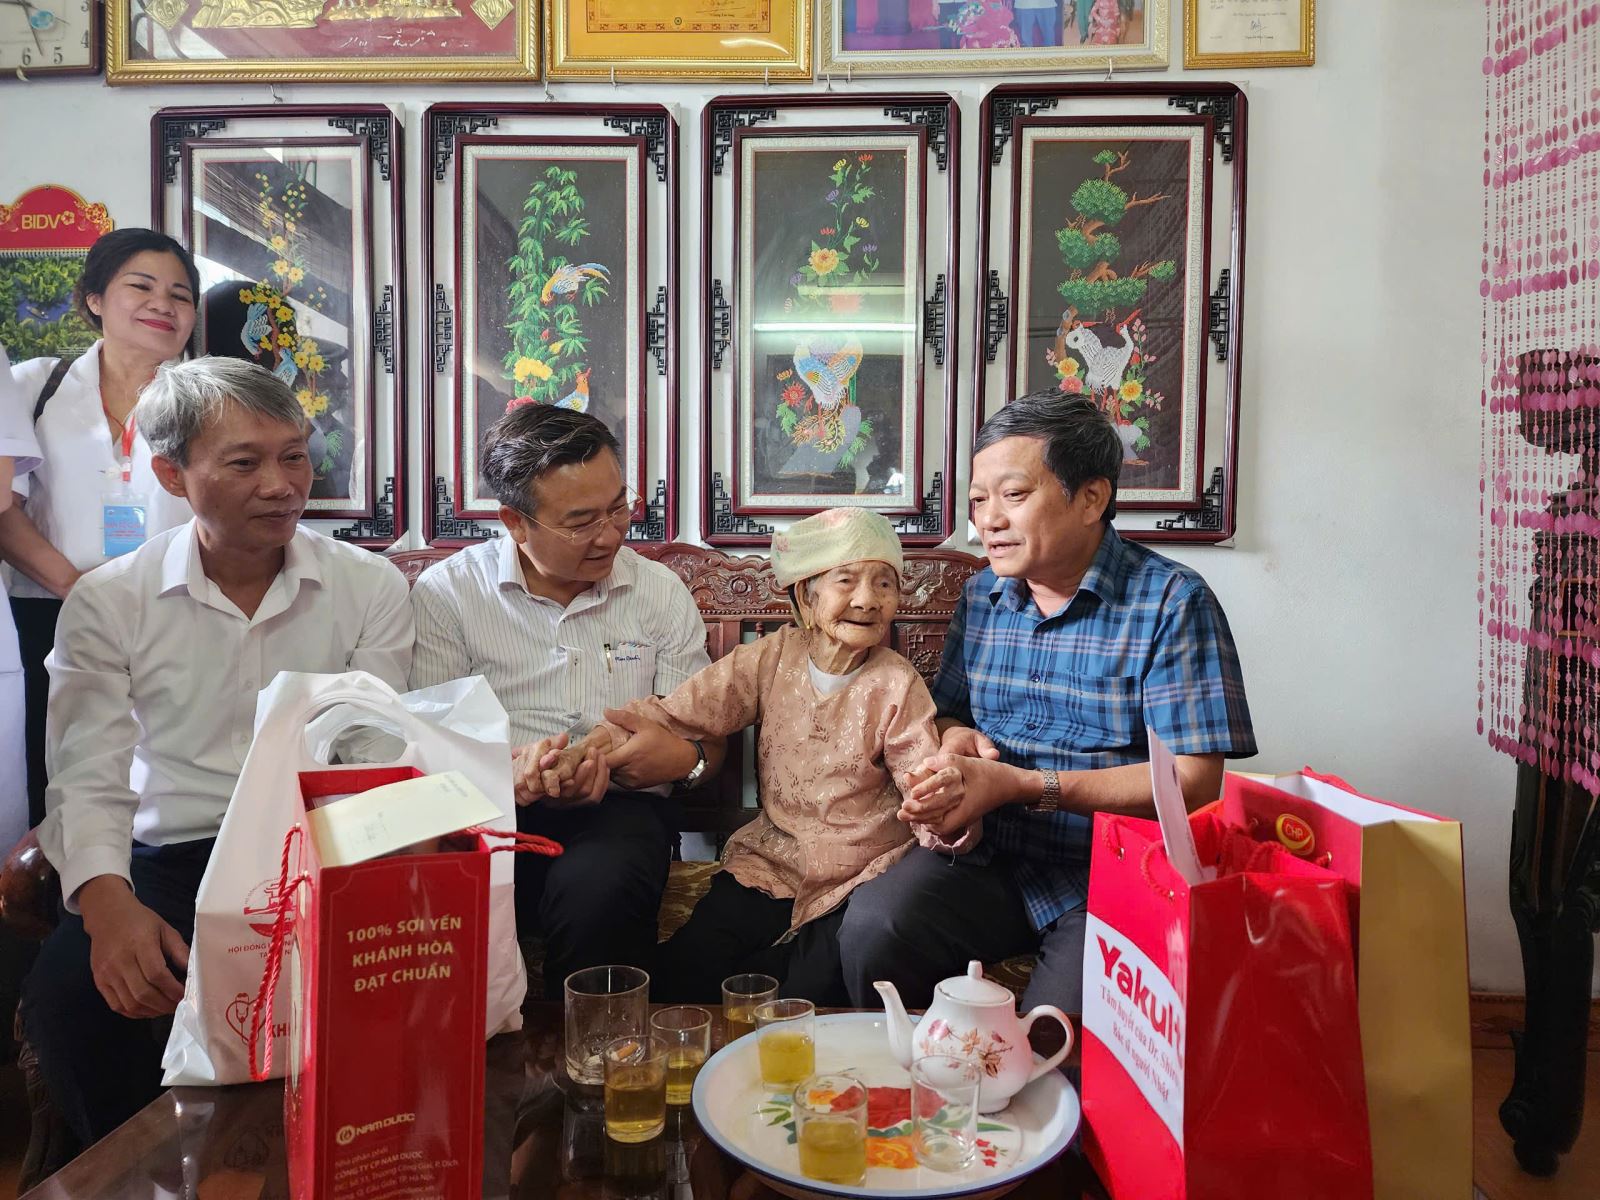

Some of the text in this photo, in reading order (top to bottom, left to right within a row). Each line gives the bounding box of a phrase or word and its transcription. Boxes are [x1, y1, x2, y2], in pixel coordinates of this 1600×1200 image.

[81, 30, 89, 48] 4
[22, 47, 31, 65] 6
[53, 46, 63, 64] 5
[21, 214, 61, 229] BIDV
[347, 913, 461, 943] 100% SỢI YẾN
[352, 940, 453, 968] KHÁNH HÒA
[354, 962, 451, 992] ĐẠT CHUẨN
[1096, 933, 1184, 1069] Yakult
[1147, 1035, 1159, 1062] Dr.
